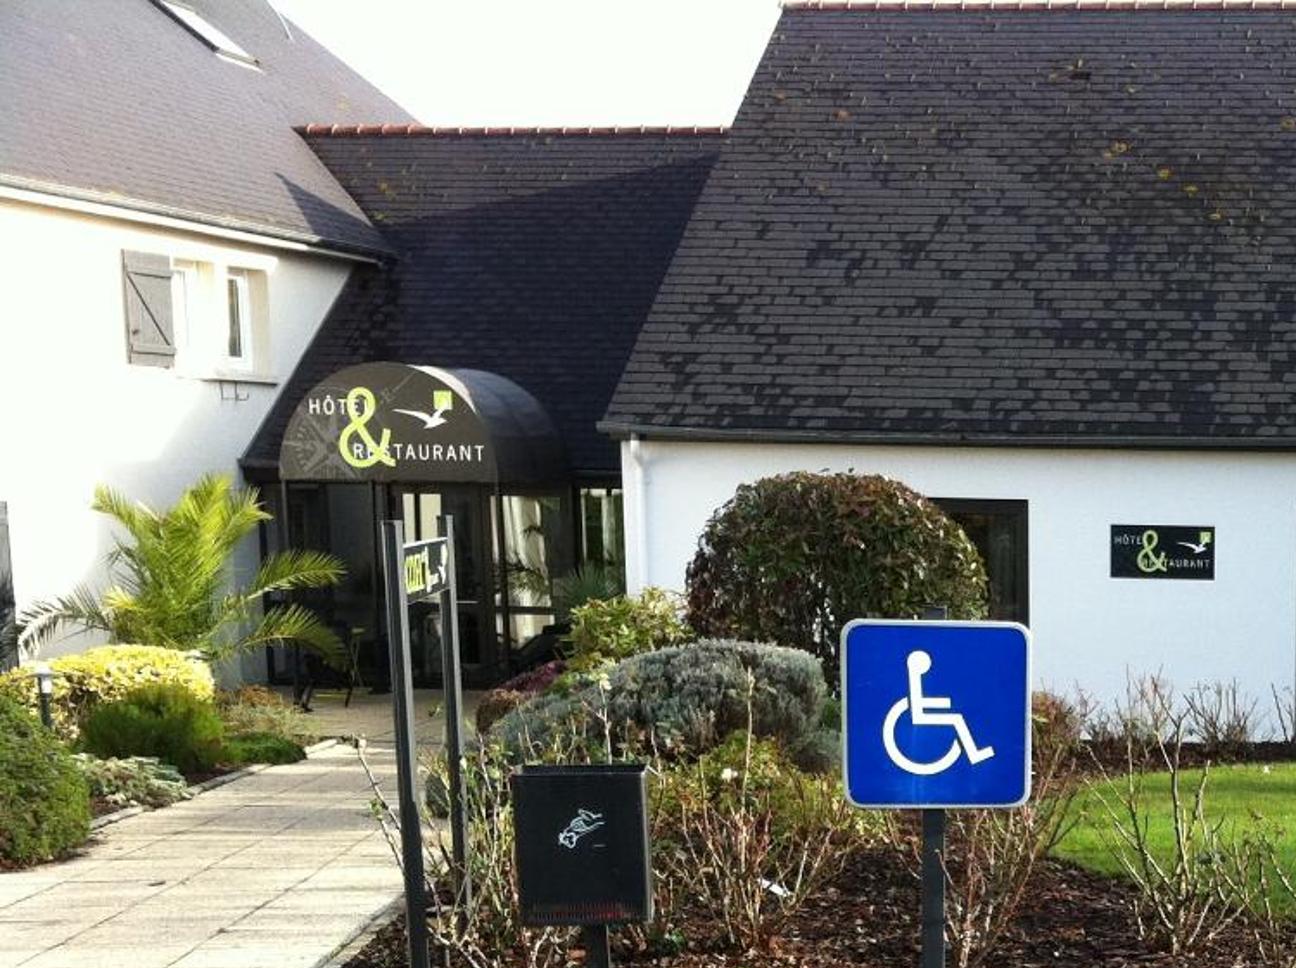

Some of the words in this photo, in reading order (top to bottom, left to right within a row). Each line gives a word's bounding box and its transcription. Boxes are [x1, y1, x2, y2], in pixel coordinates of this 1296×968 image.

[339, 387, 396, 468] &
[1114, 534, 1145, 545] HÔTE
[1137, 530, 1167, 572] &
